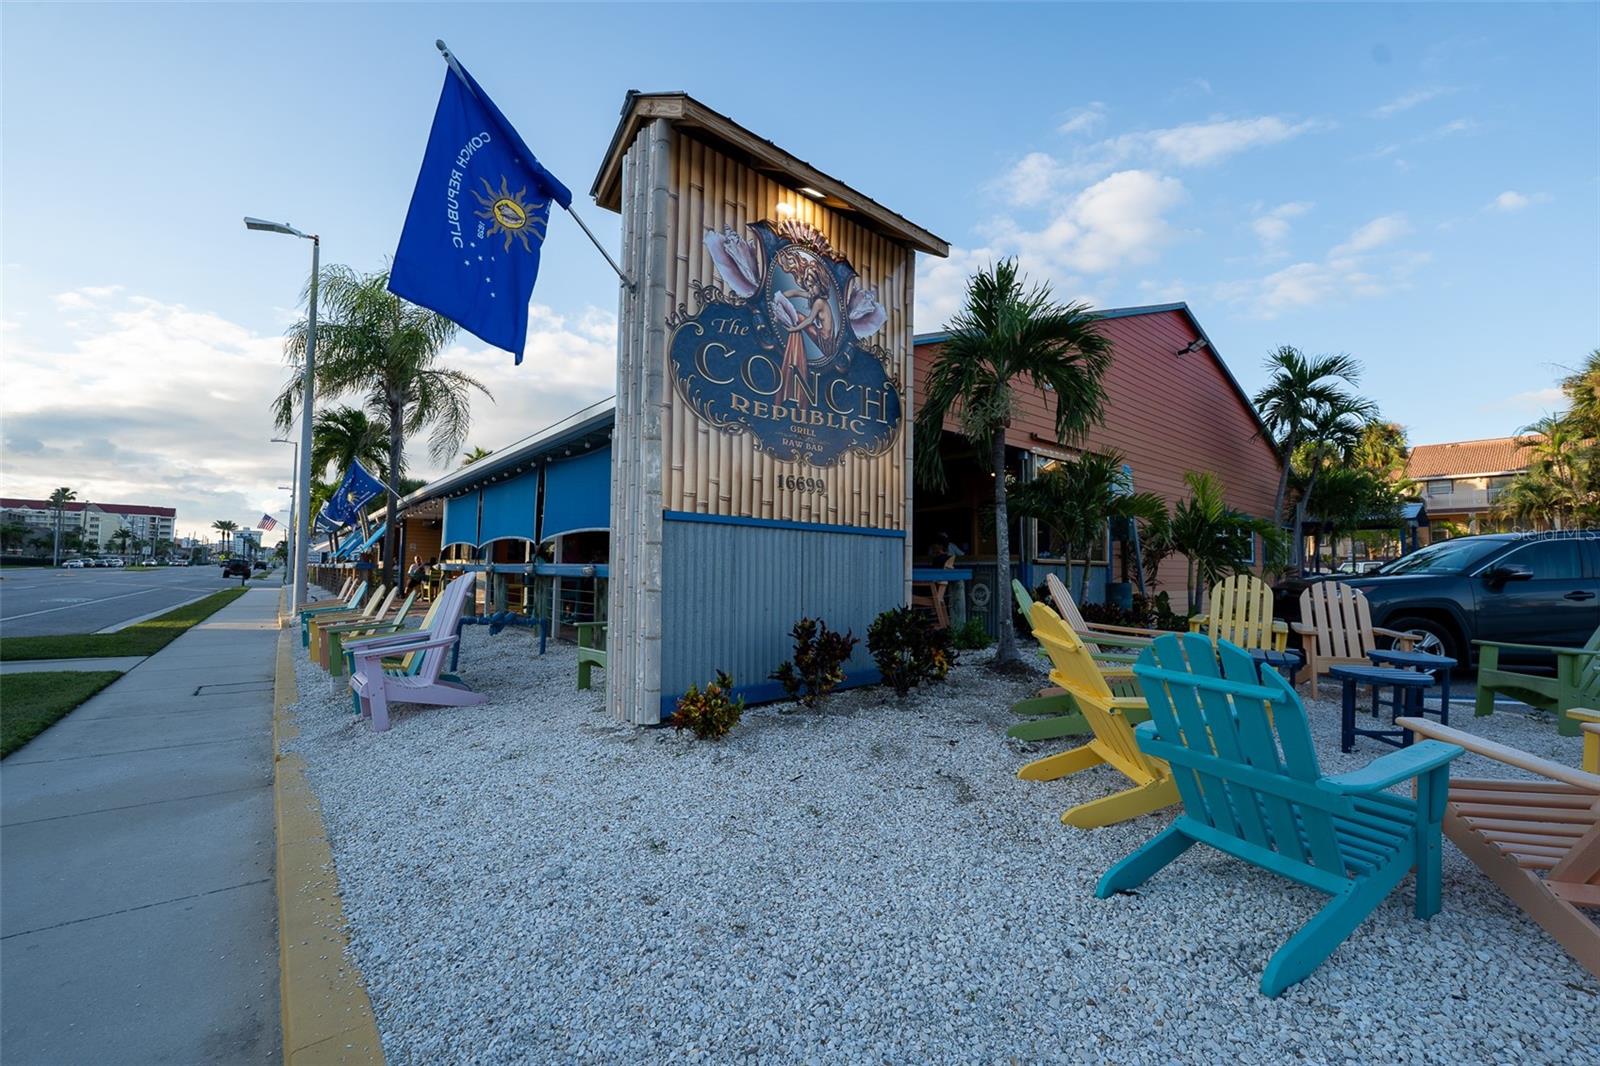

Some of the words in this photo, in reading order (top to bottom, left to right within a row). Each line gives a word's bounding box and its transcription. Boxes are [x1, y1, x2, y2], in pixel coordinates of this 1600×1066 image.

[711, 318, 749, 336] The
[695, 342, 890, 424] CONCH
[730, 392, 866, 435] REPUBLIC
[790, 425, 817, 437] GRILL
[782, 438, 803, 449] RAW
[805, 442, 824, 453] BAR
[777, 474, 826, 496] 16699
